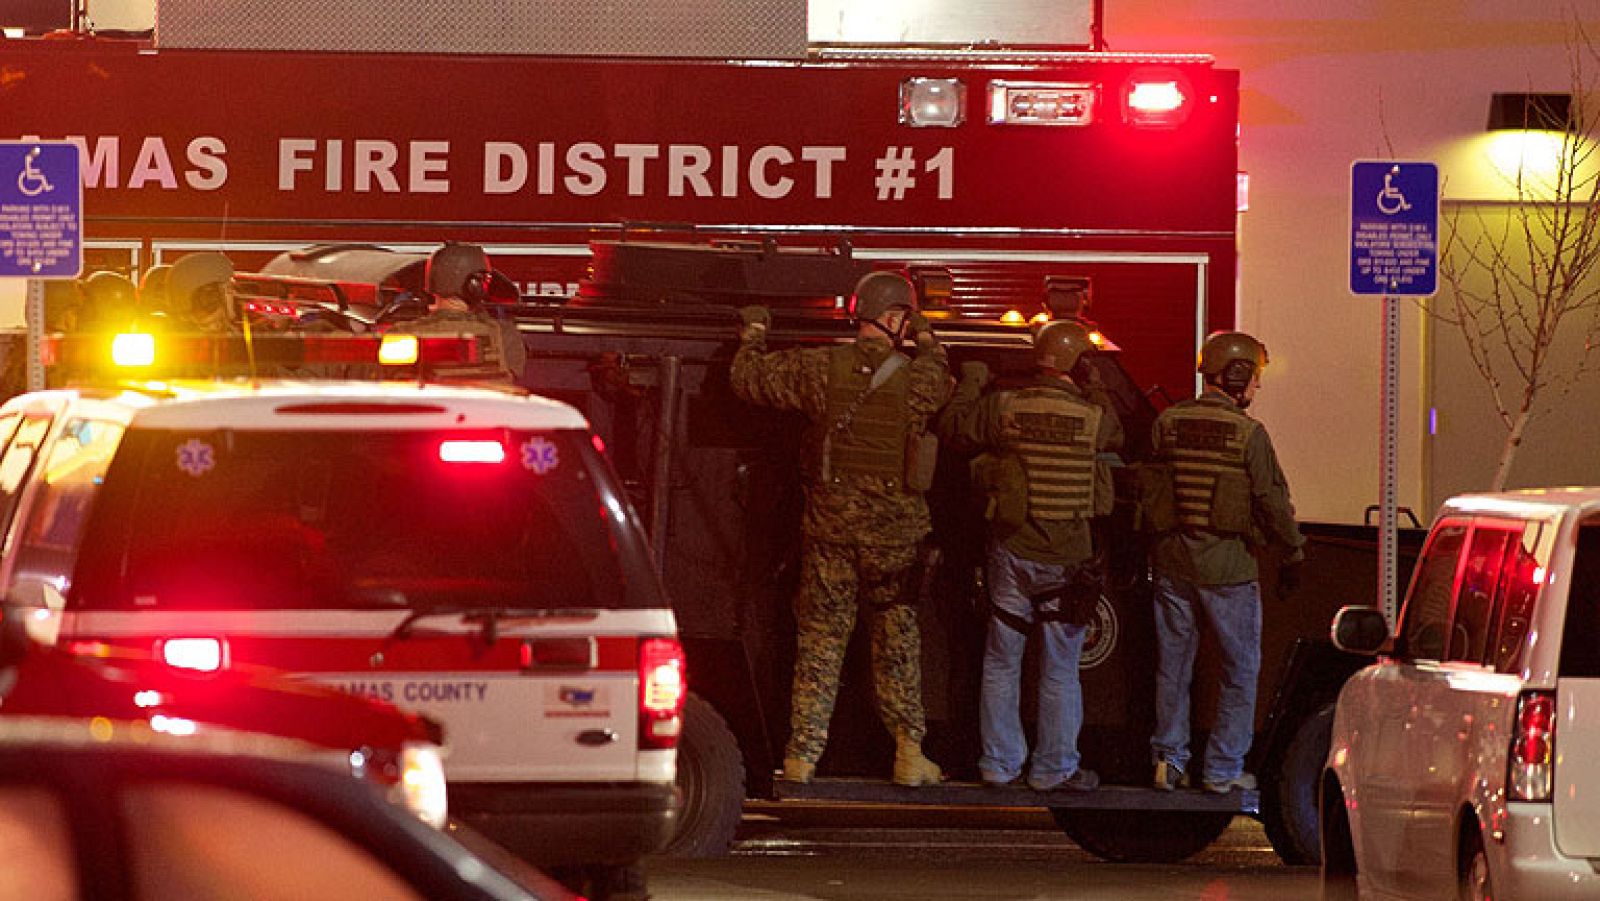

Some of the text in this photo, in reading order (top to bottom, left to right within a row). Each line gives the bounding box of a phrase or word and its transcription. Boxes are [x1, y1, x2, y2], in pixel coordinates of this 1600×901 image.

[20, 135, 955, 200] MAS FIRE DISTRICT #1
[404, 682, 488, 701] COUNTY
